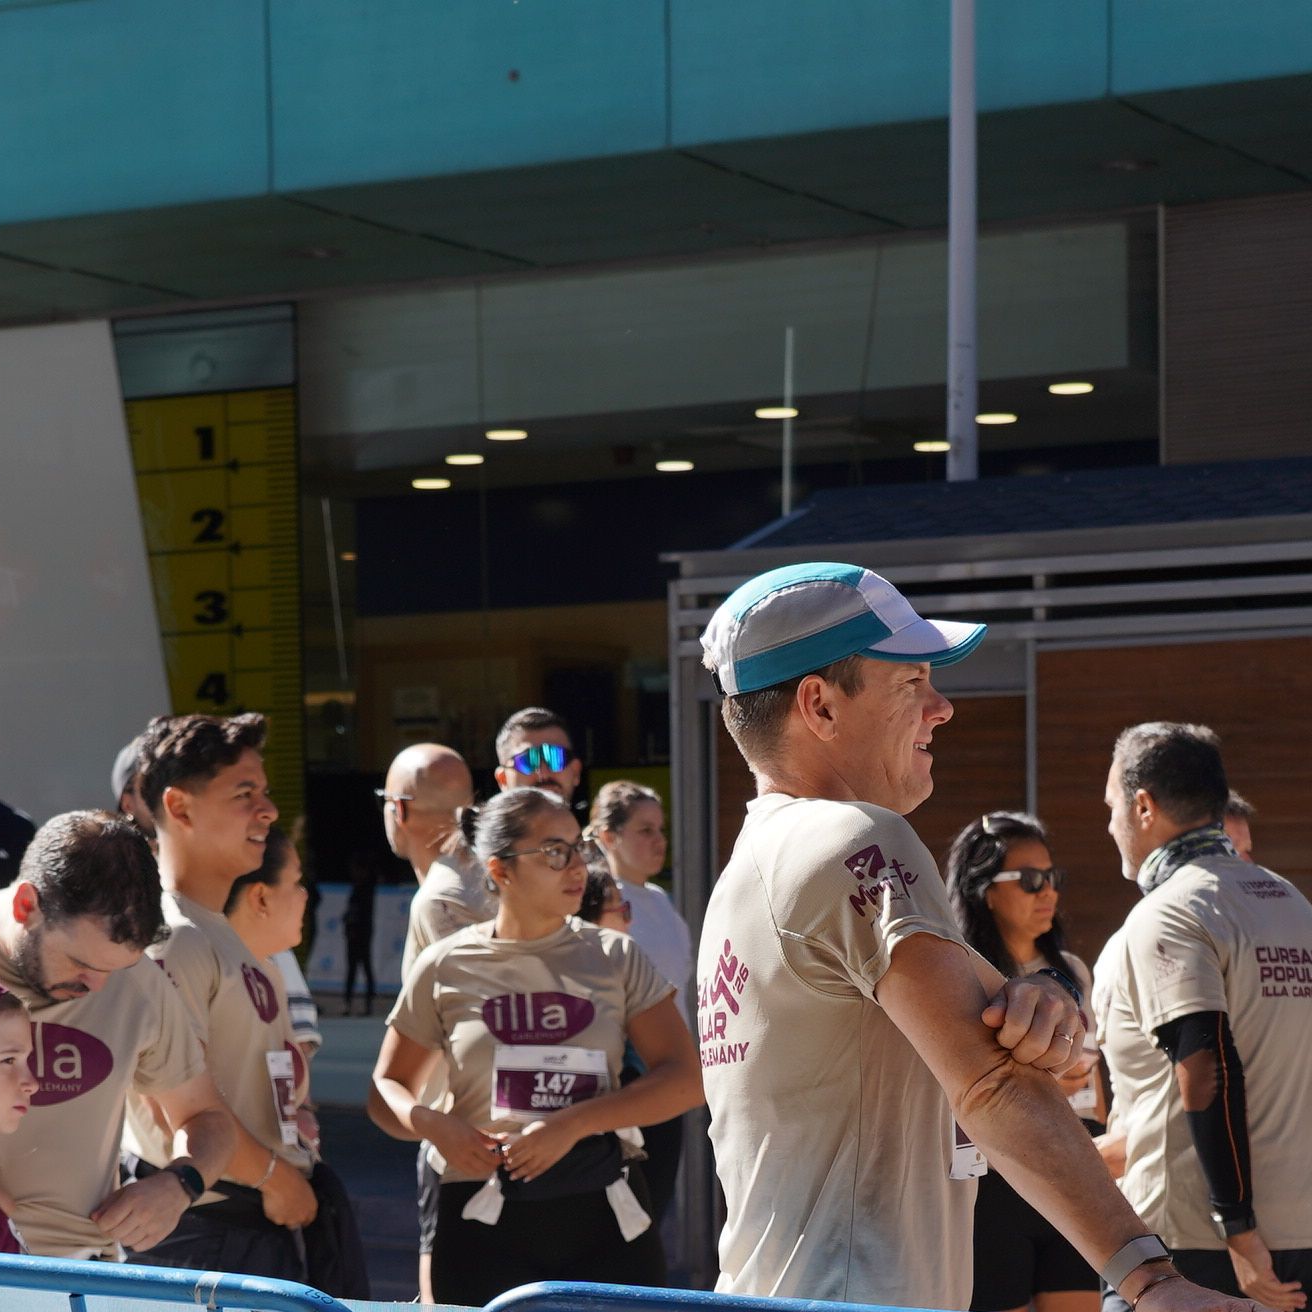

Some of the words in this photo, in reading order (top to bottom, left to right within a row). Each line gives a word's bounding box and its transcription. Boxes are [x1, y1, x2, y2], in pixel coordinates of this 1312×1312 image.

[194, 425, 215, 461] 1
[192, 509, 226, 543] 2
[194, 590, 229, 625] 3
[196, 673, 229, 705] 4
[1255, 946, 1312, 964] CURSA
[1262, 985, 1288, 997] ILLA
[494, 991, 567, 1032] illa
[34, 1020, 82, 1080] la
[38, 1083, 82, 1092] LEMANY
[533, 1071, 576, 1095] 147
